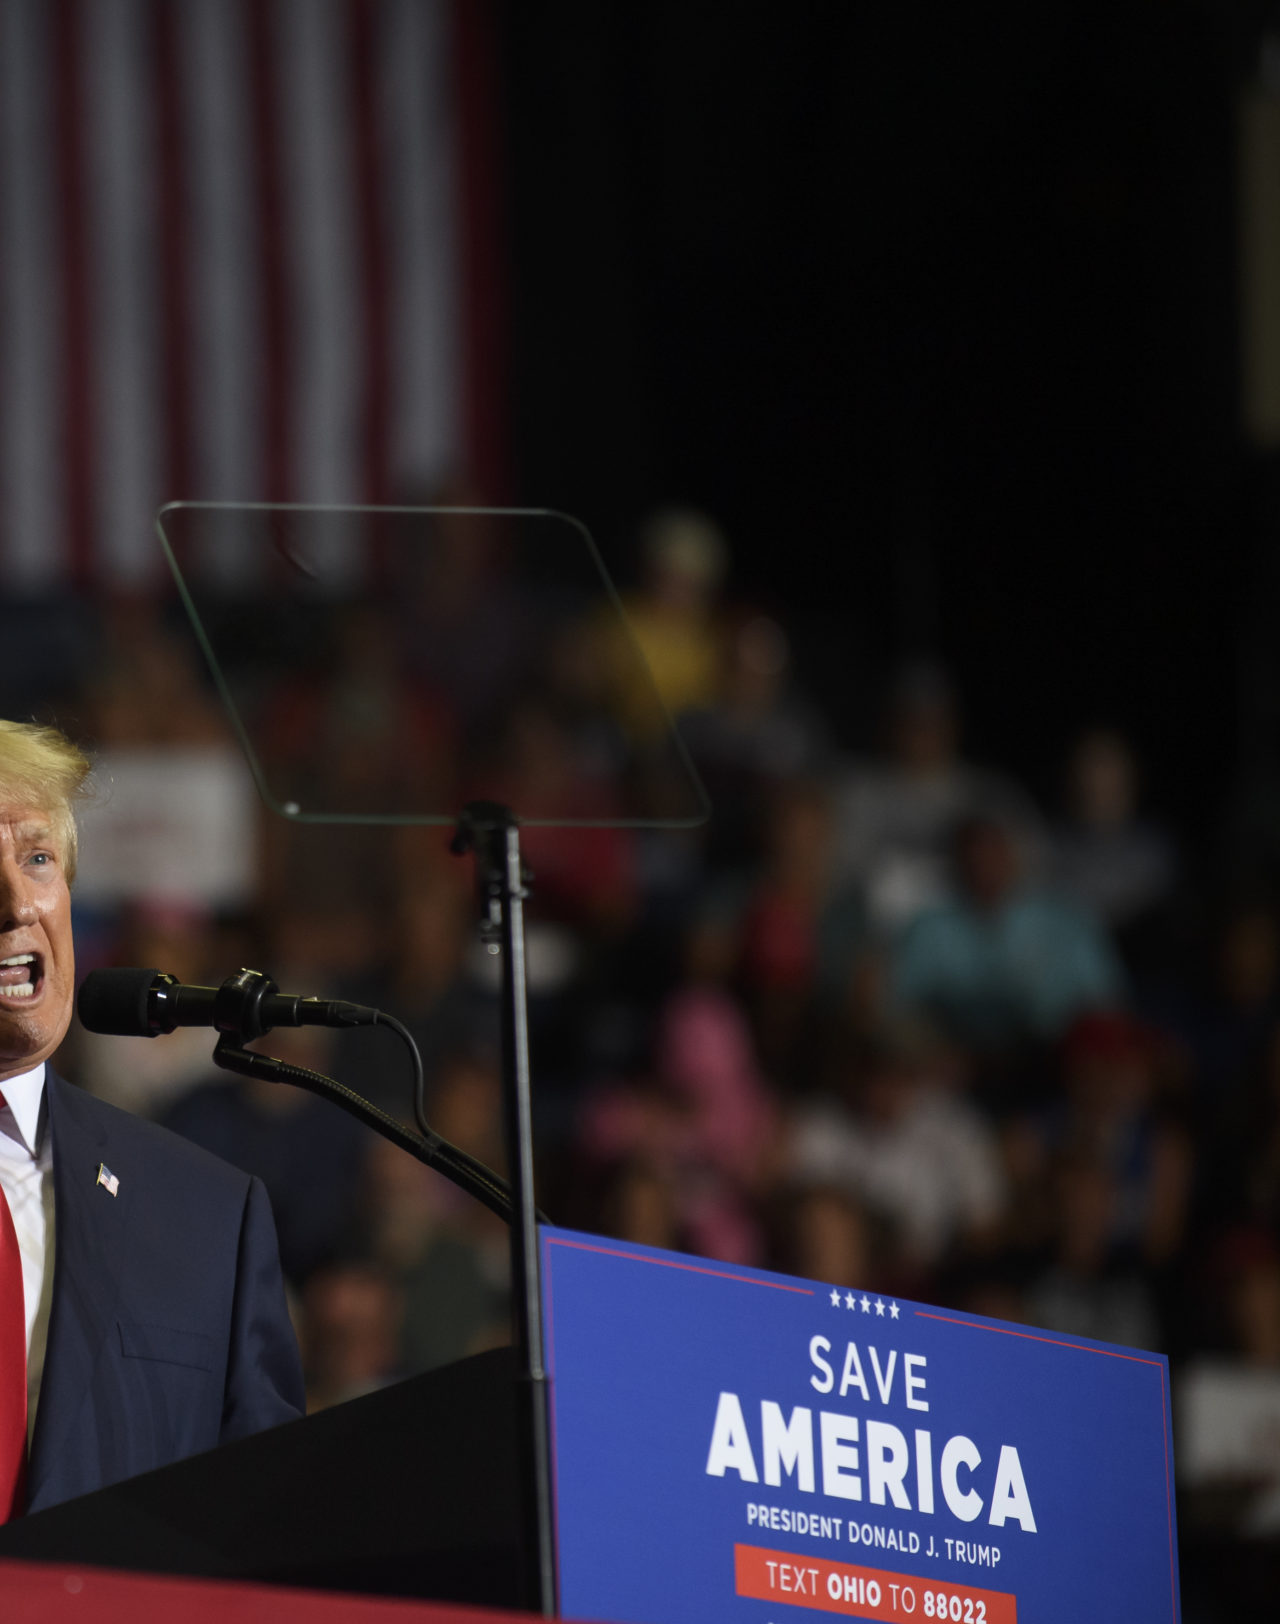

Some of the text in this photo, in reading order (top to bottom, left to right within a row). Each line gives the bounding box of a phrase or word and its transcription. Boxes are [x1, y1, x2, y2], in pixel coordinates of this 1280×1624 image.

[809, 1334, 930, 1412] SAVE
[706, 1391, 1038, 1533] AMERICA
[746, 1502, 1001, 1568] PRESIDENT DONALD J. TRUMP
[765, 1560, 987, 1624] TEXT OHIO TO 88022
